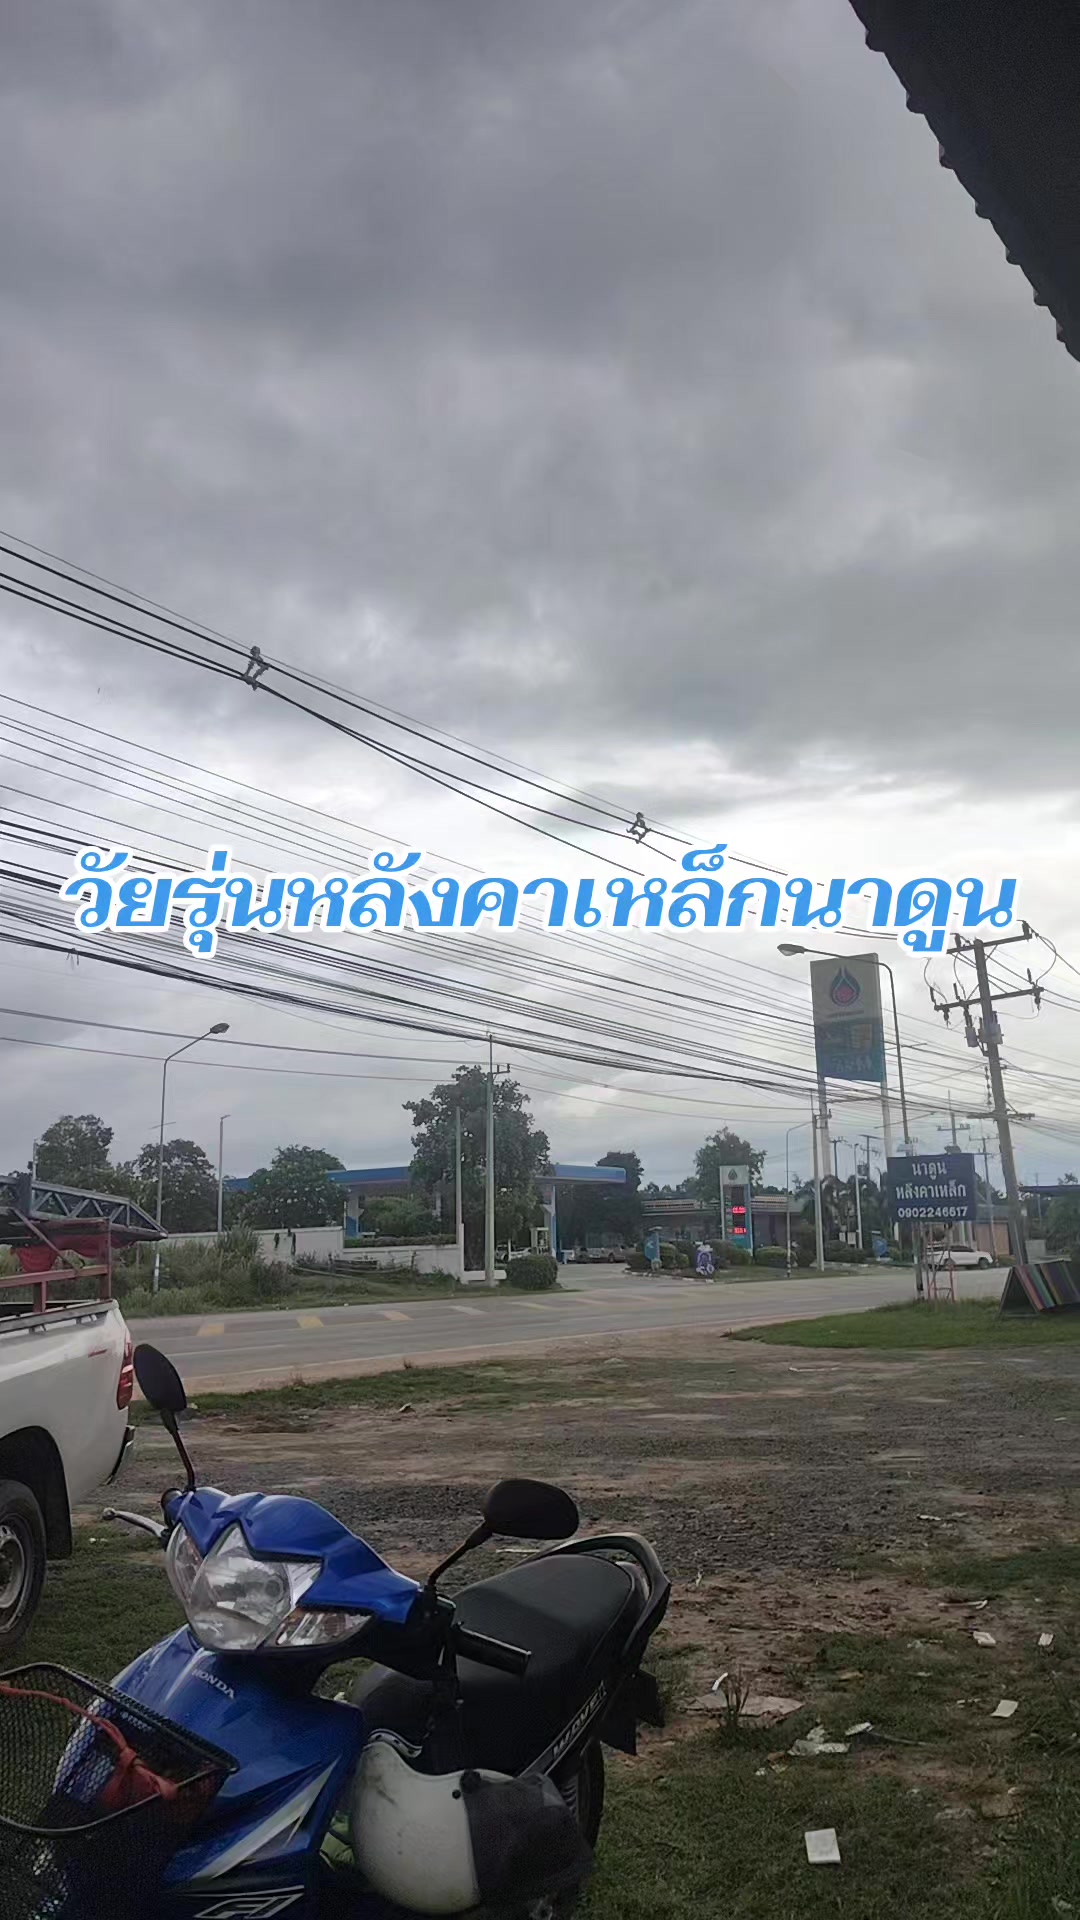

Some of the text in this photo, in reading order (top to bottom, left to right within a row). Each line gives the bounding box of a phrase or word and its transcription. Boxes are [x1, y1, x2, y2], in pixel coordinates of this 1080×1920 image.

[912, 1162, 947, 1180] นาดูน
[895, 1180, 967, 1199] หลังคาเหล็ก
[191, 1669, 235, 1699] HONDA
